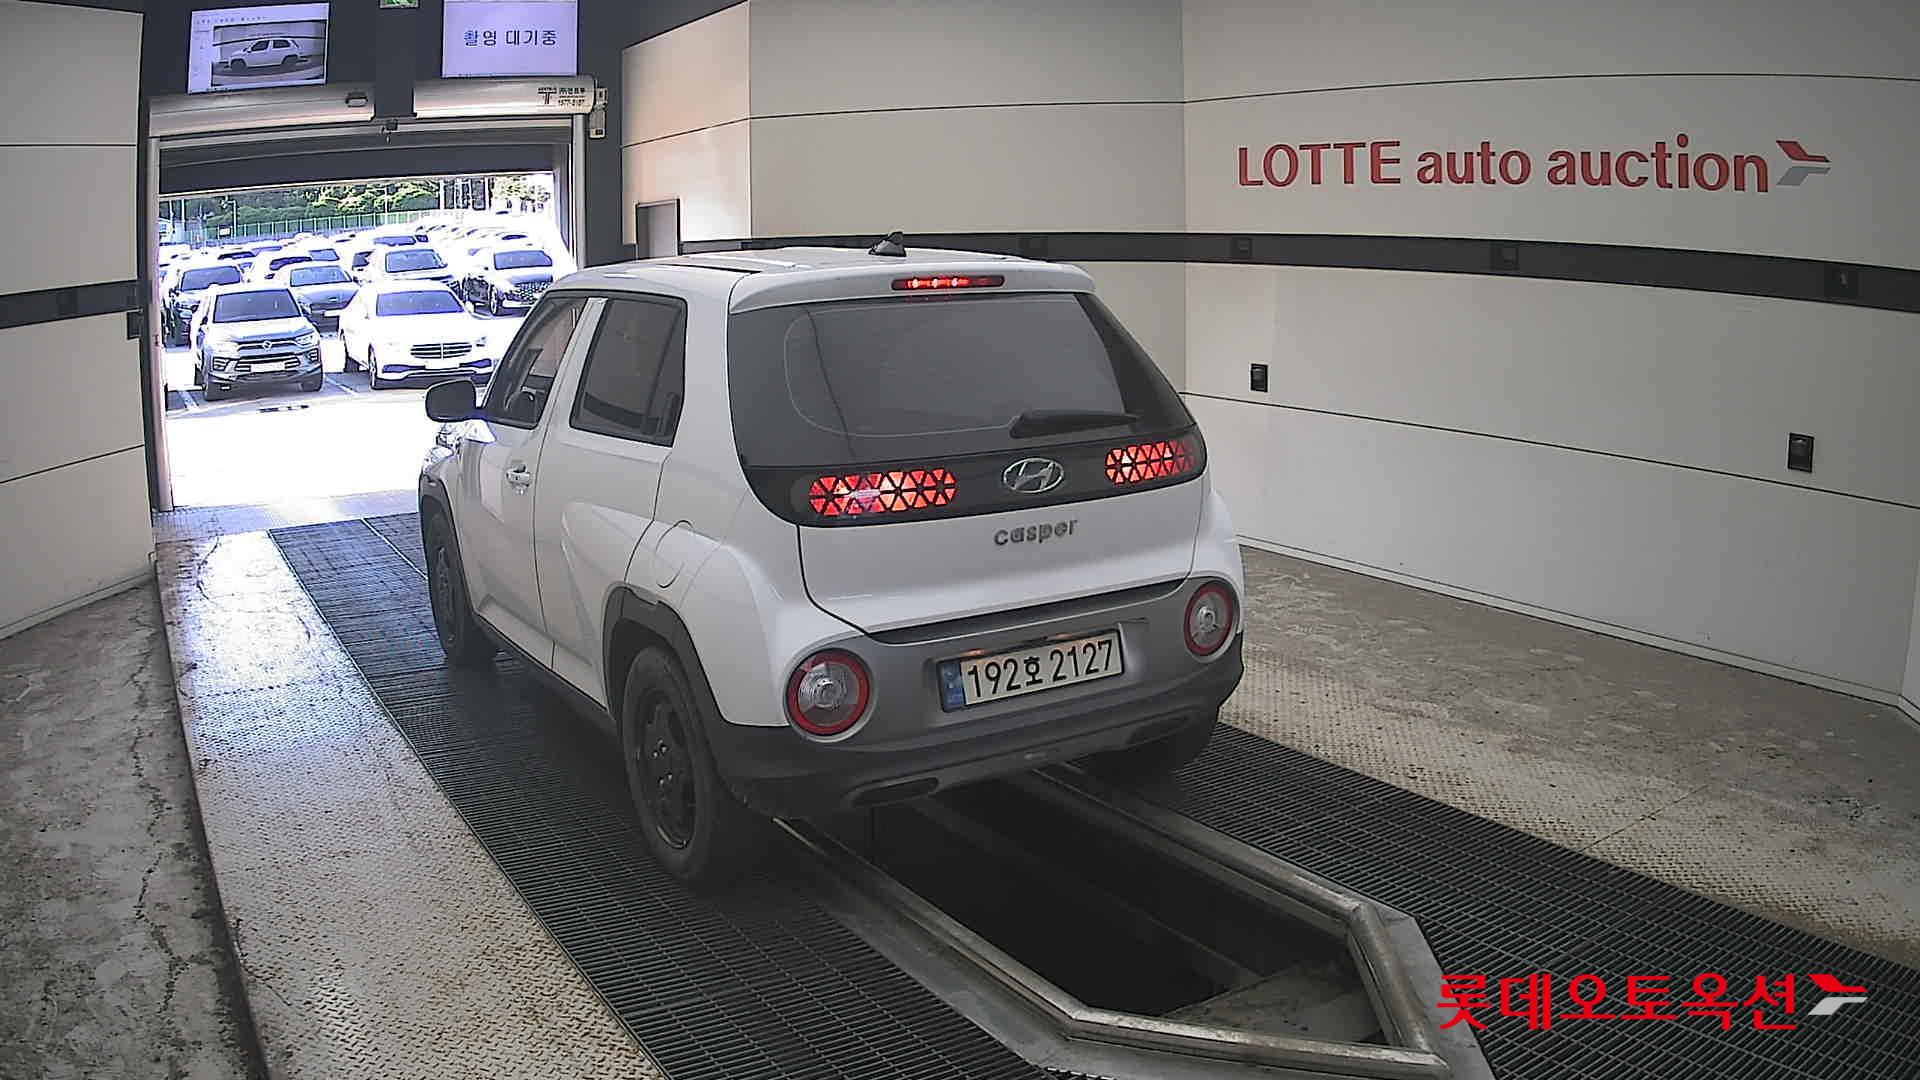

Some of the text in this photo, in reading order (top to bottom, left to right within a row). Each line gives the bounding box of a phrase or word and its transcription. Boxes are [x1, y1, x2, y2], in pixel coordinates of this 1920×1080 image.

[464, 30, 557, 46] 촬영 대기중
[1238, 133, 1769, 193] LOTTE auto auction
[994, 519, 1078, 546] casper
[967, 639, 1113, 698] 192호 2127
